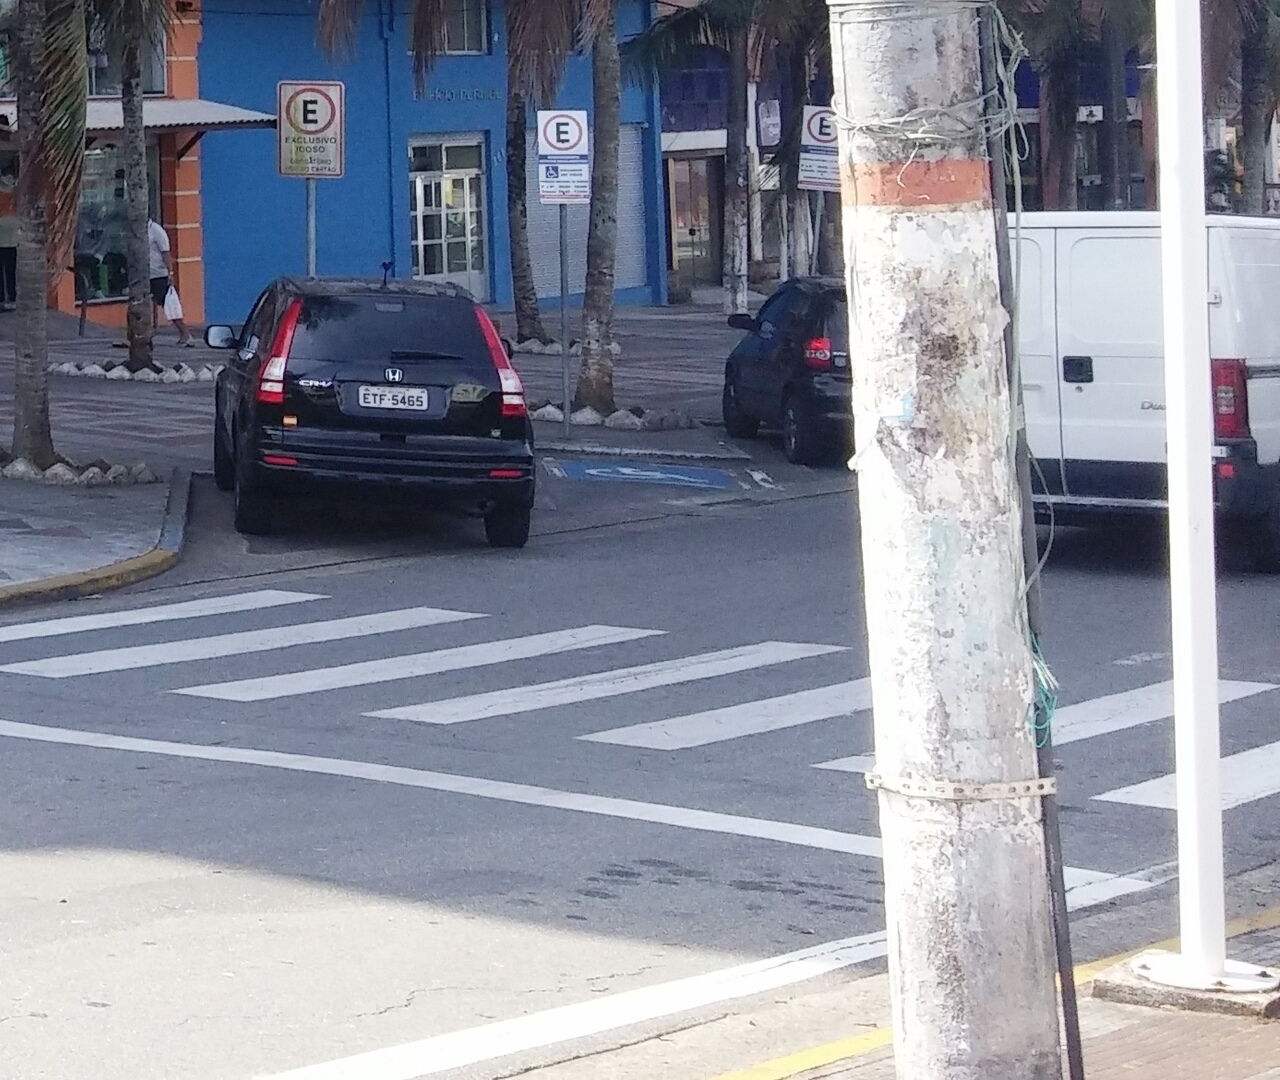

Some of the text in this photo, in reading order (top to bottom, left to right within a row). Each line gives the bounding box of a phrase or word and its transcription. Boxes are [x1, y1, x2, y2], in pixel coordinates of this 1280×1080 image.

[302, 99, 318, 124] E
[556, 122, 570, 143] E
[818, 116, 831, 136] E
[284, 136, 337, 145] EXCLUSIVO
[296, 145, 326, 153] IDOSO
[362, 393, 424, 407] ETF-5465
